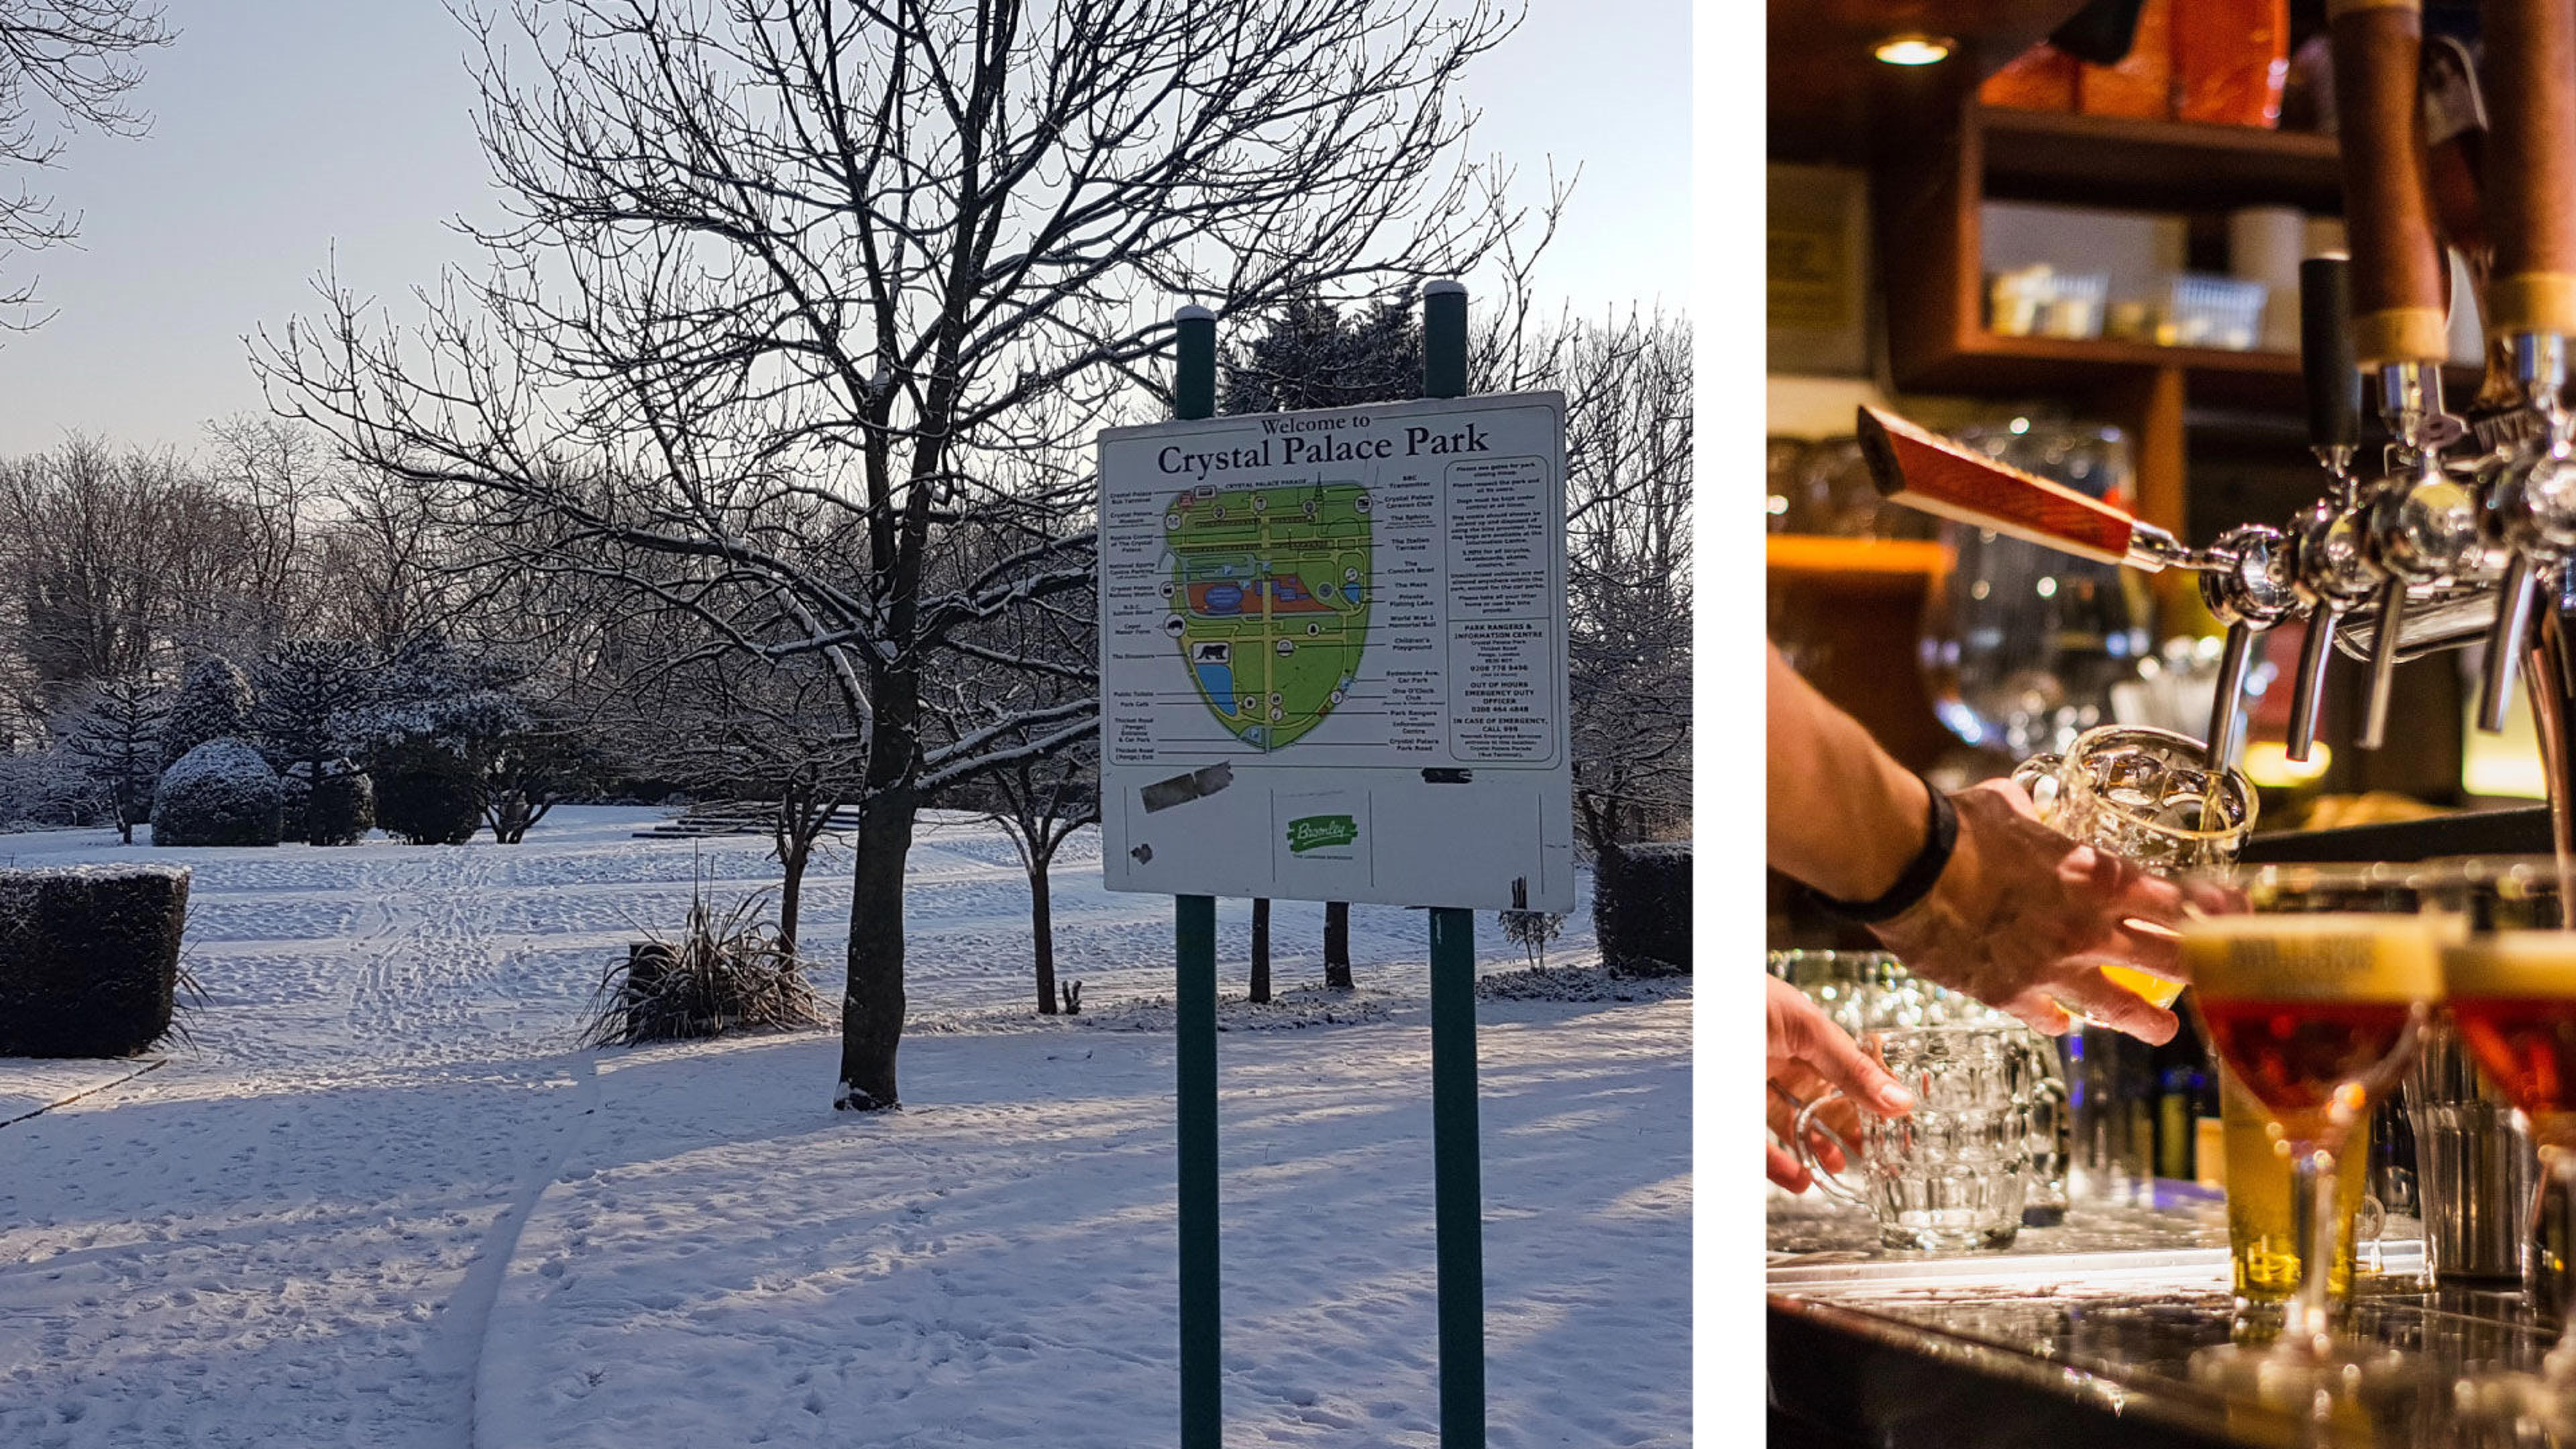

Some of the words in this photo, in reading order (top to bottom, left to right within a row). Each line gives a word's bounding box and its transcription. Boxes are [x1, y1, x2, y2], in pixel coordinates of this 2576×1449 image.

[1262, 417, 1345, 435] Welcome
[1352, 416, 1370, 429] to
[1159, 440, 1271, 480] Crystal
[1282, 434, 1391, 466] Palace
[1405, 423, 1489, 456] Park
[1297, 820, 1345, 839] Bromley
